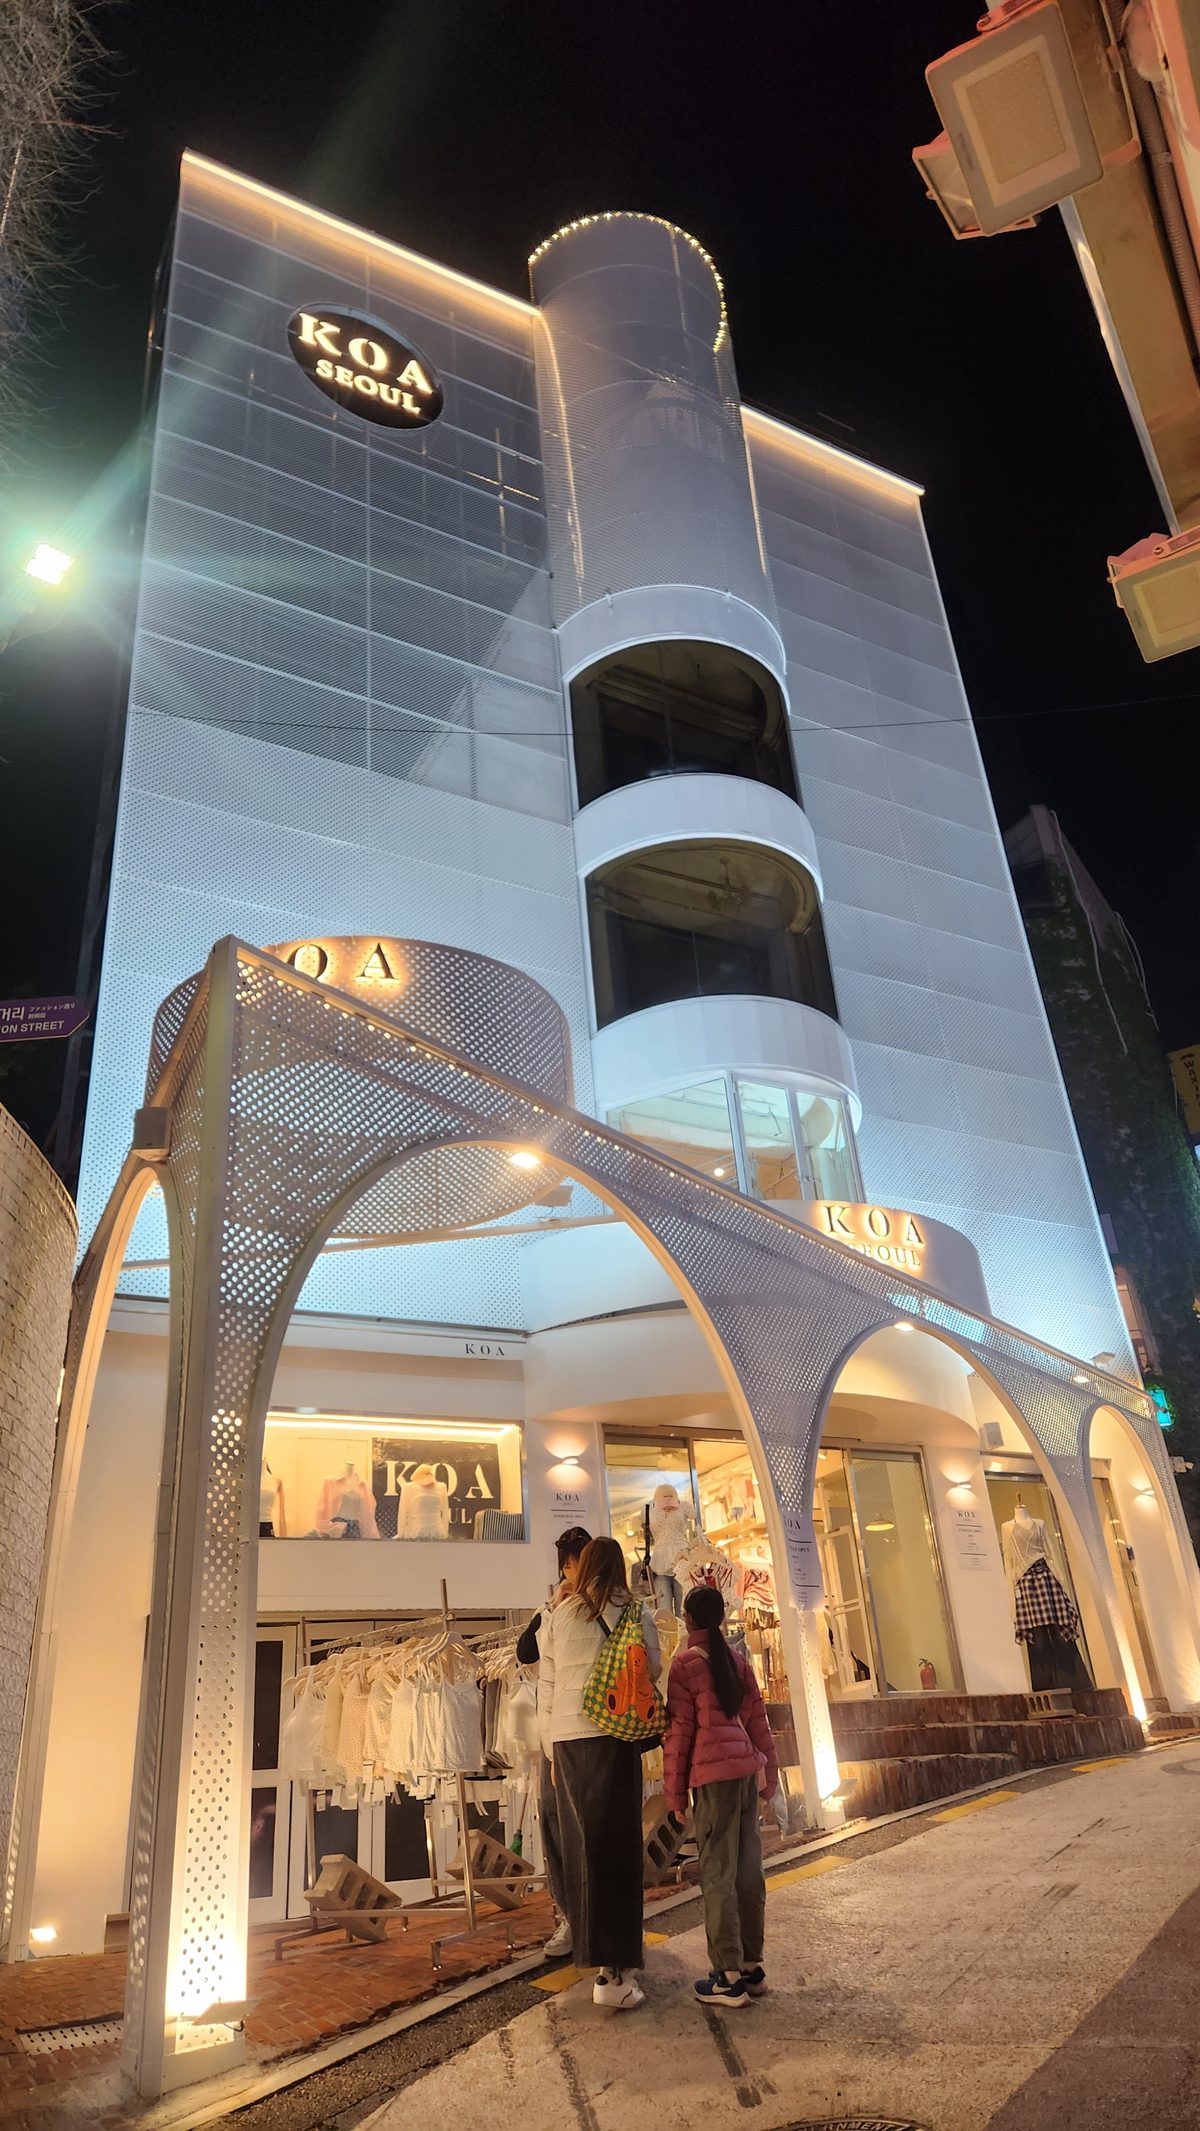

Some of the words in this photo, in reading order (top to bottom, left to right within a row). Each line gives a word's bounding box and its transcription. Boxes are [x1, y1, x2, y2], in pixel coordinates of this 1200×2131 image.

[298, 312, 433, 394] KOA
[315, 359, 421, 415] SEOUL
[286, 942, 400, 980] OA
[0, 1024, 18, 1034] ON
[20, 1020, 65, 1032] STREET
[822, 1205, 925, 1245] KOA
[465, 1343, 505, 1356] KOA
[383, 1460, 494, 1499] KOA
[556, 1493, 580, 1502] KOA
